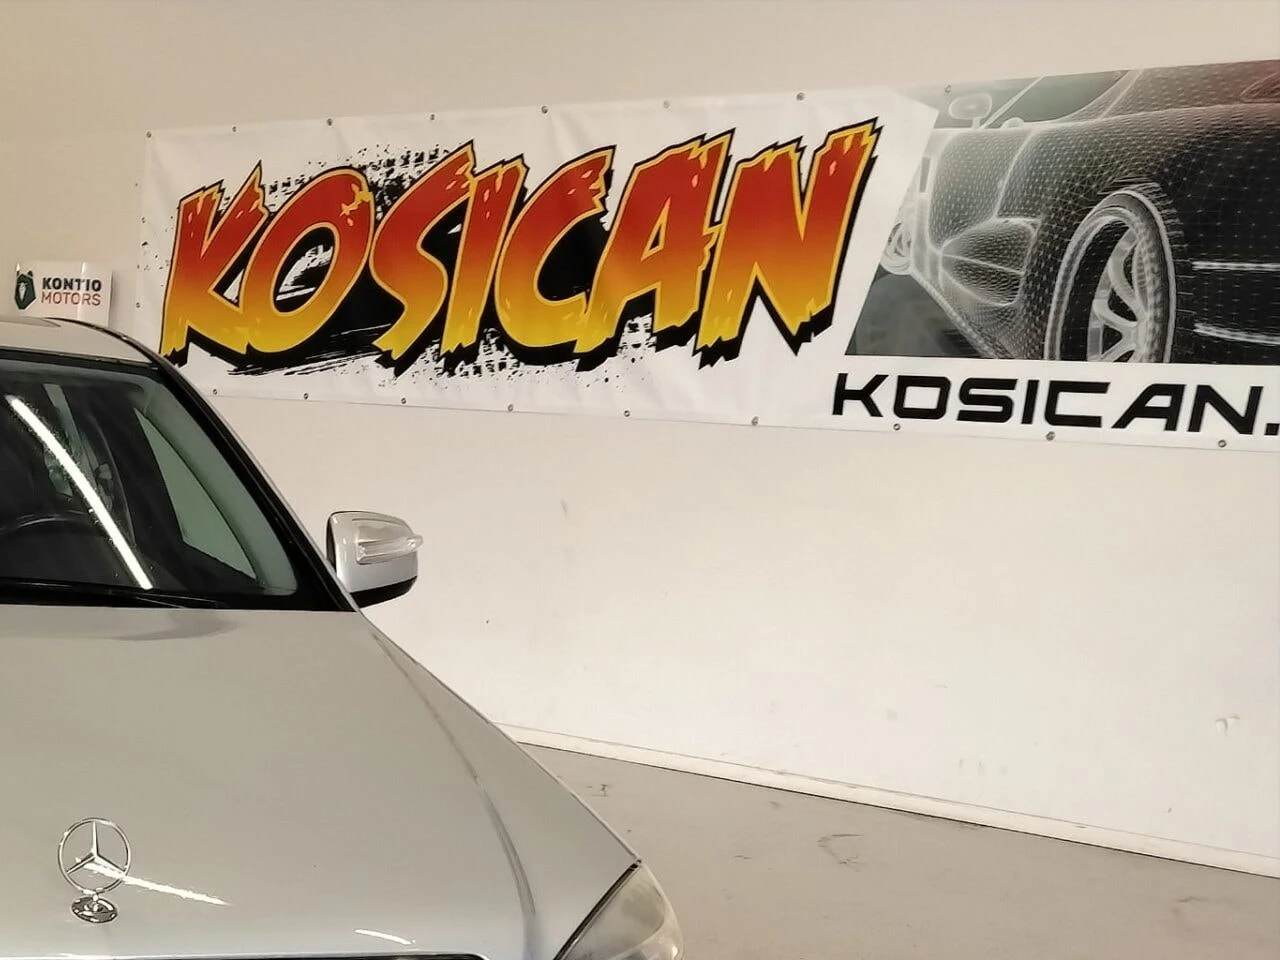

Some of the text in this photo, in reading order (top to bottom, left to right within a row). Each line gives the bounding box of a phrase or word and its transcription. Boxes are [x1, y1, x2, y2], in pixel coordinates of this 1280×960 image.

[159, 116, 884, 372] KOSICAN
[42, 277, 102, 292] KONTIO
[40, 290, 102, 307] MOTORS
